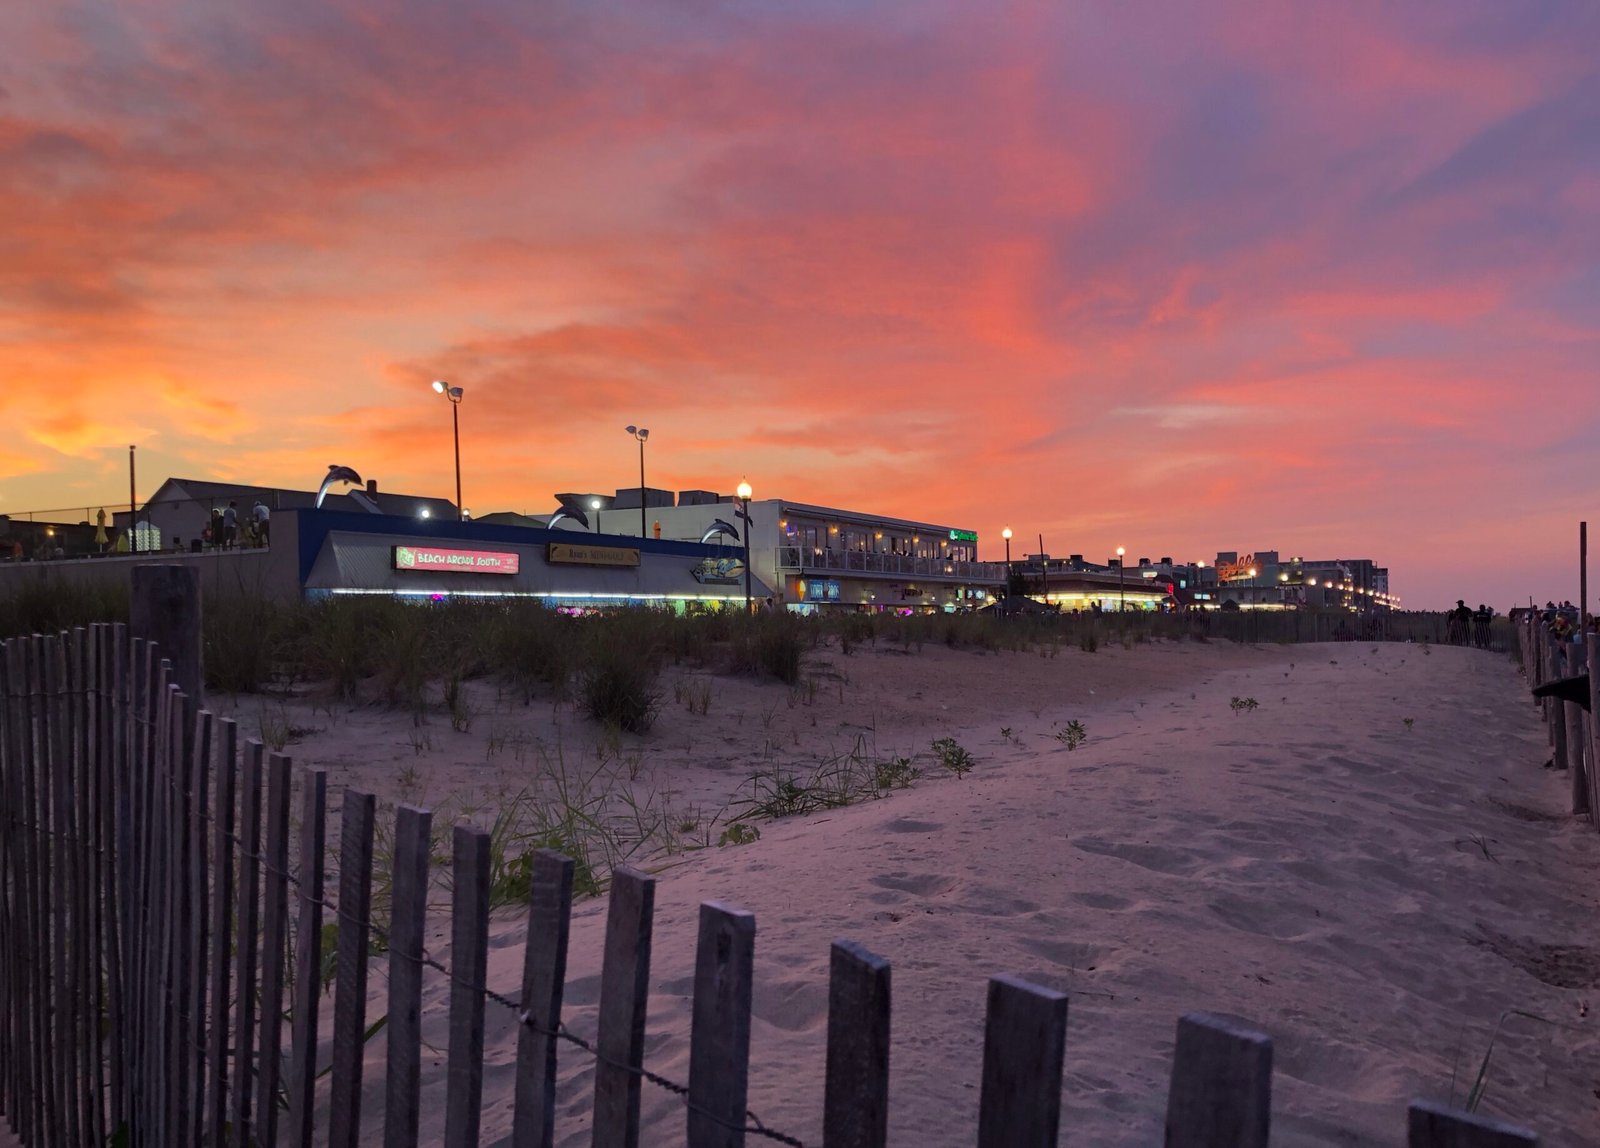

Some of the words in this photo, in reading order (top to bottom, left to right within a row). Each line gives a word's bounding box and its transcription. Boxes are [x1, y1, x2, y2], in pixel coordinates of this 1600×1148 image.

[417, 553, 445, 564] BEACH
[447, 555, 474, 566] ARCADE
[476, 556, 501, 567] SOUTH
